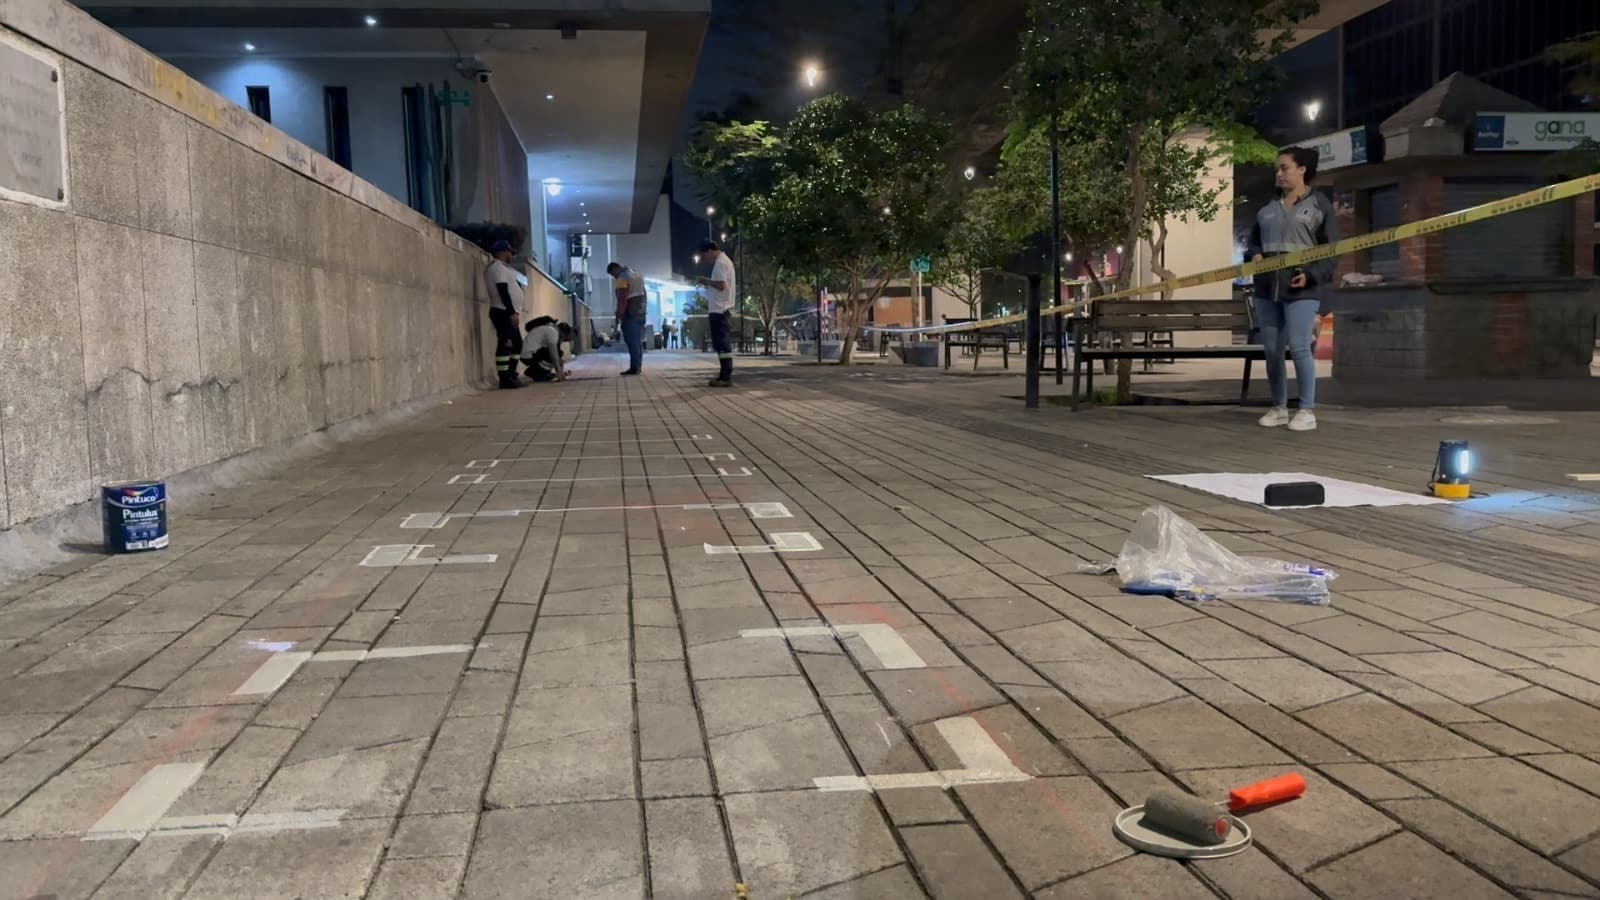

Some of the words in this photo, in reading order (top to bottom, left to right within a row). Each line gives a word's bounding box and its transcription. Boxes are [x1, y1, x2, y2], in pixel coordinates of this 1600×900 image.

[1535, 120, 1585, 141] gana
[121, 495, 156, 504] Pintuco
[122, 509, 158, 519] Pintulux
